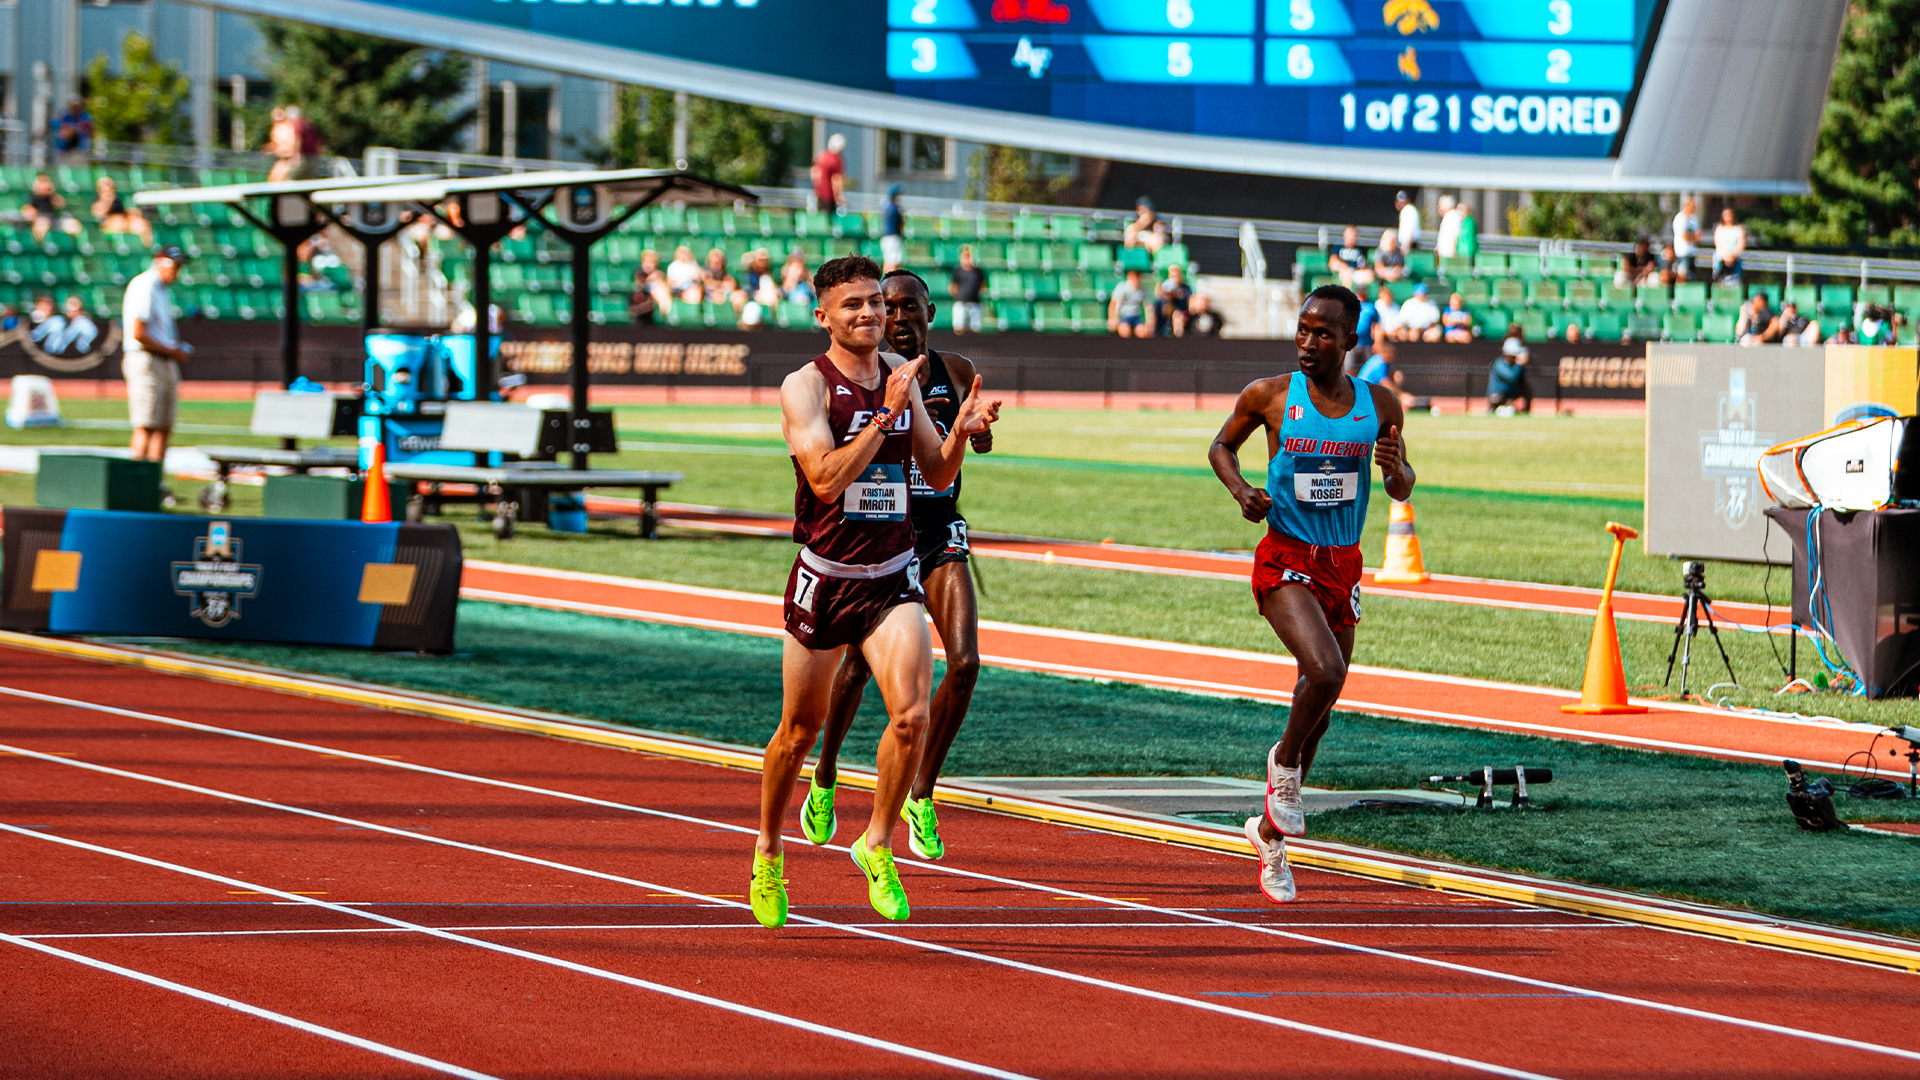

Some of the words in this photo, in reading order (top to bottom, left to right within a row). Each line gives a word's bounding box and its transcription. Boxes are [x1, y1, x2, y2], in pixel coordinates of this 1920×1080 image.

[1166, 0, 1194, 28] 6
[1289, 0, 1315, 31] 5
[1547, 0, 1573, 35] 3
[910, 37, 938, 73] 3
[1167, 42, 1193, 77] 5
[1287, 44, 1314, 79] 6
[1545, 48, 1572, 84] 2
[1340, 93, 1356, 131] 1
[1365, 94, 1408, 132] of
[1470, 95, 1622, 135] SCORED
[1558, 356, 1646, 388] DIVISIO
[929, 385, 948, 396] ACC
[1284, 437, 1318, 453] NEW
[1319, 440, 1371, 458] MEXICO
[861, 487, 895, 498] KRISTIAN
[1310, 488, 1343, 500] KOSGEI
[1311, 478, 1343, 487] MATHEW
[859, 499, 896, 512] IMROTH
[798, 571, 814, 604] 7
